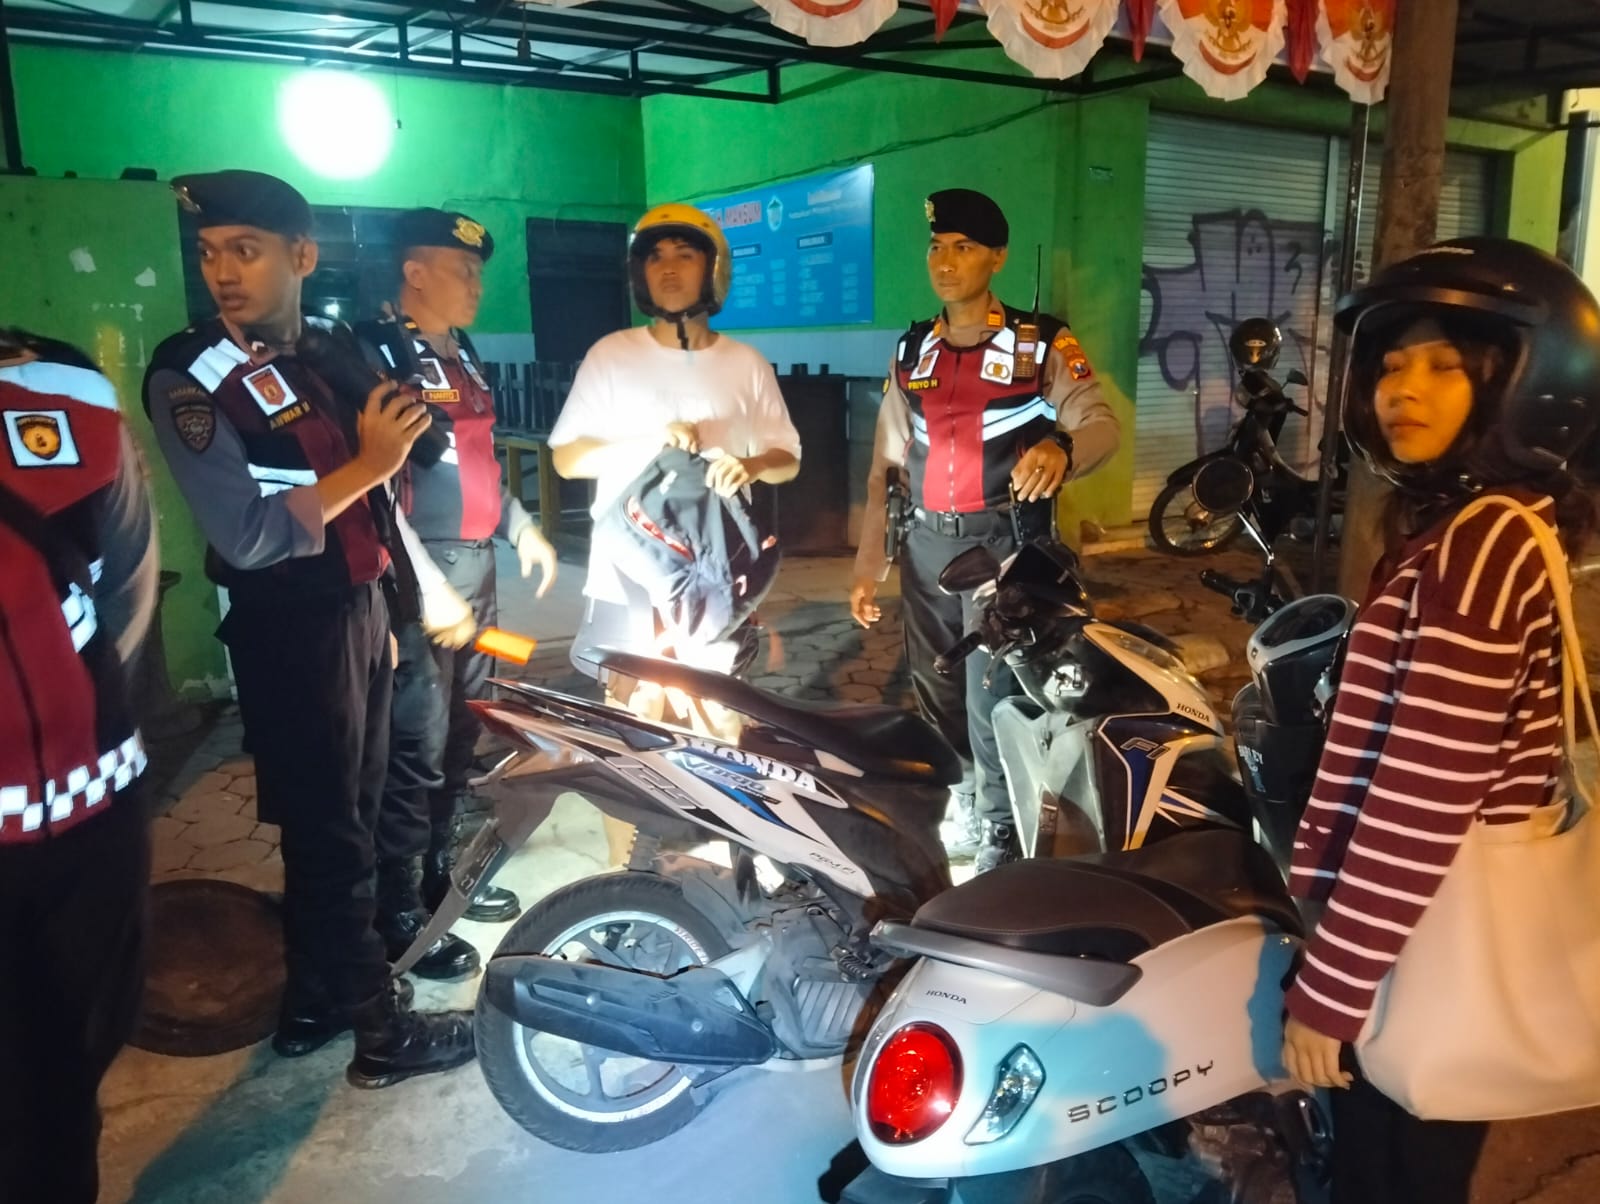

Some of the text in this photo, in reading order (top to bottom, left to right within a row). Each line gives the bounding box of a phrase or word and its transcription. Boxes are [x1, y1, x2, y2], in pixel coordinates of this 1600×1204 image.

[1176, 703, 1210, 722] HONDA
[687, 736, 817, 793] HONDA
[925, 990, 967, 1004] HONDA
[1067, 1060, 1214, 1123] SCOOPY
